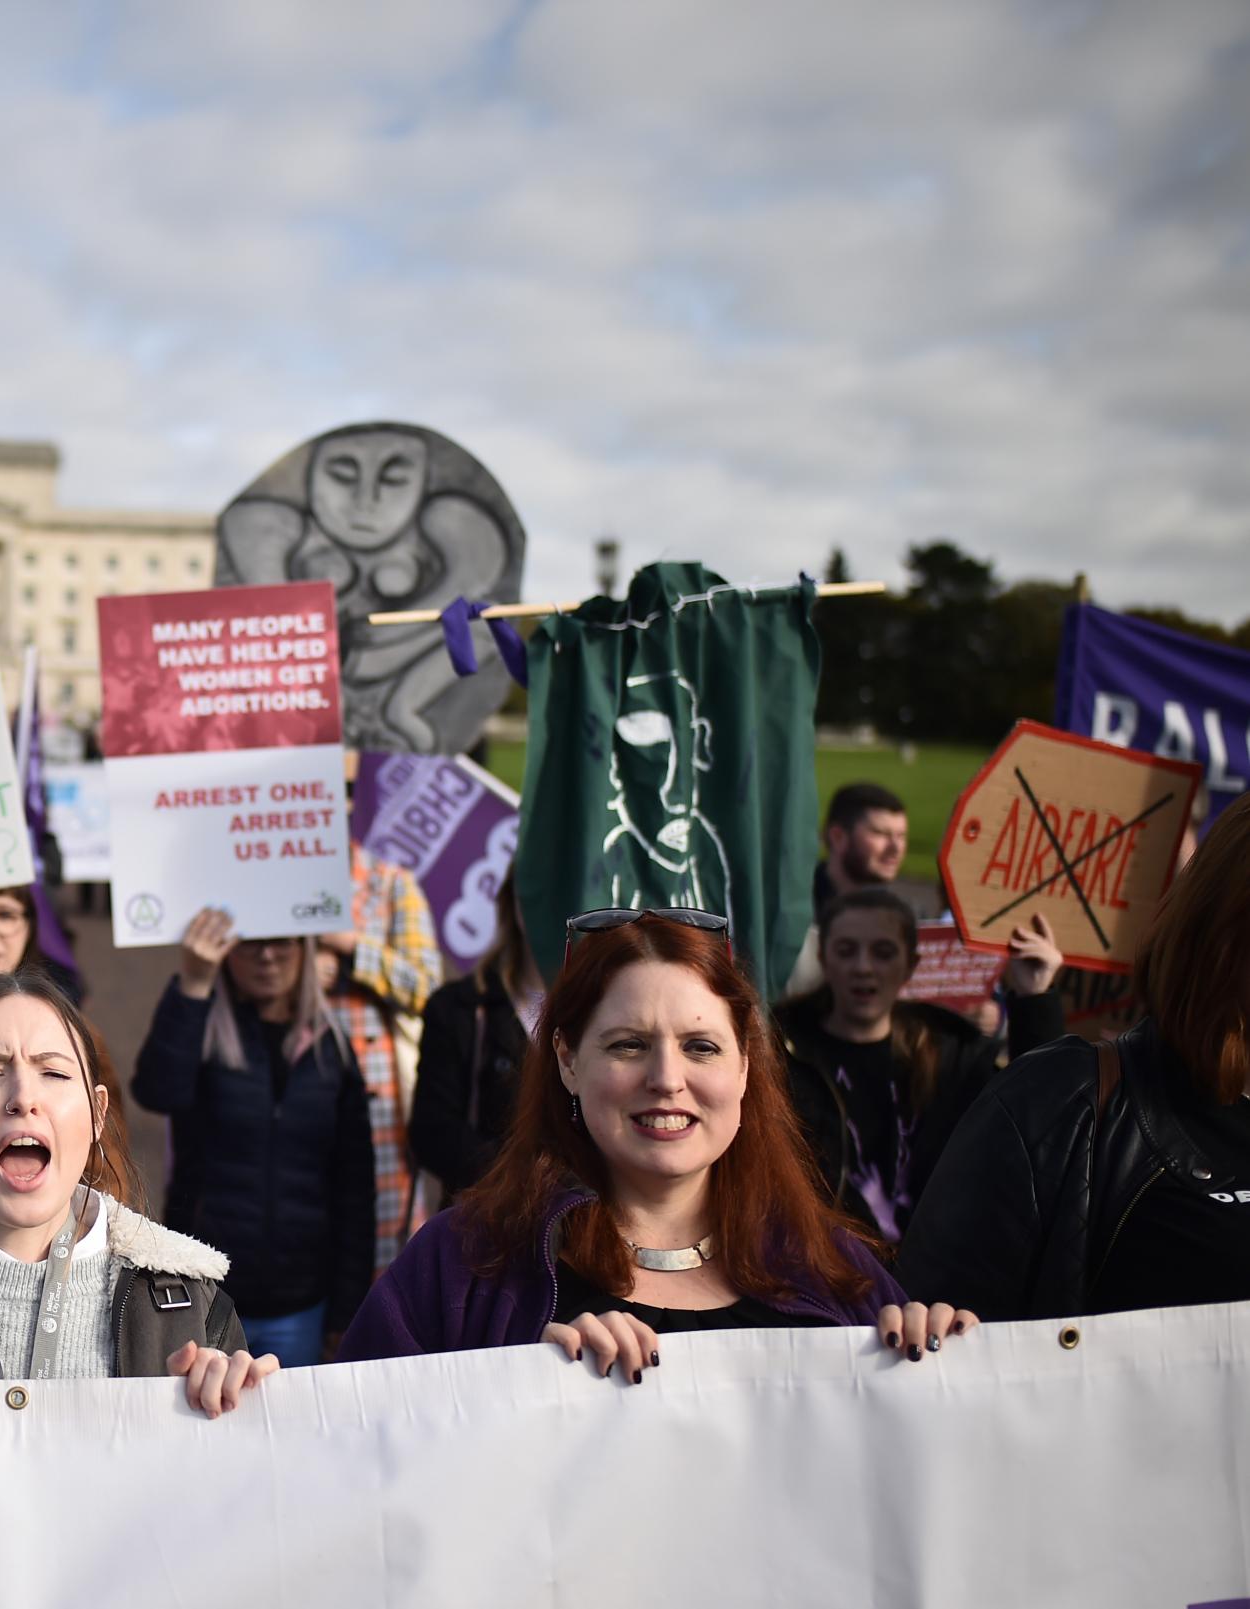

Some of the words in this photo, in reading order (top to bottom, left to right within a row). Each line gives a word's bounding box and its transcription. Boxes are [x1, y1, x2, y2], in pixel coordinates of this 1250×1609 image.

[152, 618, 224, 643] MANY
[230, 612, 326, 640] PEOPLE
[158, 643, 226, 669] HAVE
[231, 638, 329, 664] HELPED
[178, 668, 273, 693] WOMEN
[278, 663, 330, 686] GET
[180, 689, 330, 718] ABORTIONS.
[154, 785, 262, 810] ARREST
[269, 781, 335, 803] ONE,
[229, 809, 335, 834] ARREST
[234, 843, 272, 862] US
[279, 838, 338, 859] ALL.
[980, 796, 1148, 911] AIRFARE
